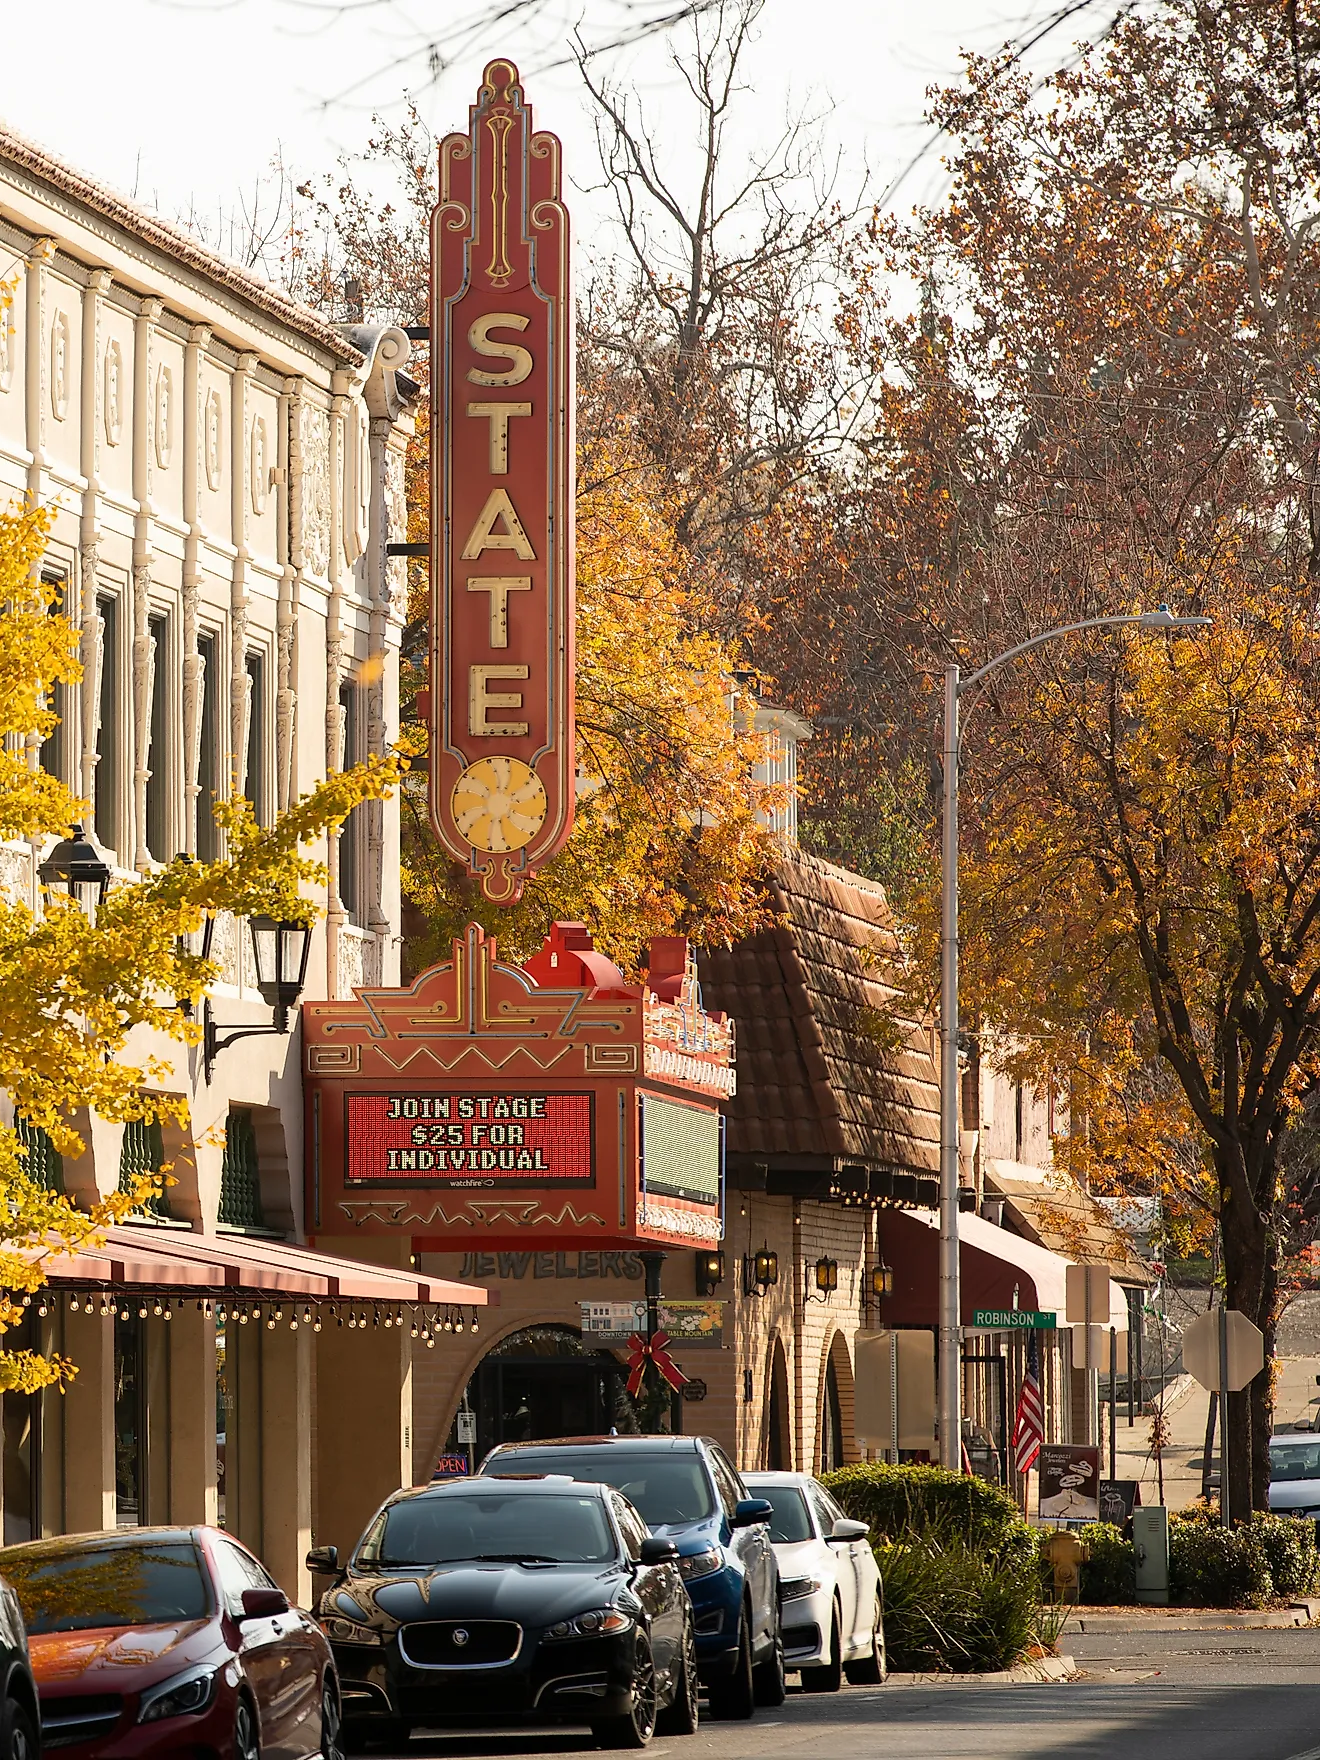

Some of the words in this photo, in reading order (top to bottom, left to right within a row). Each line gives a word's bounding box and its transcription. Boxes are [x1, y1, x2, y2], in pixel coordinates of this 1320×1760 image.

[460, 312, 538, 737] STATE
[388, 1098, 450, 1118] JOIN
[459, 1098, 545, 1118] STAGE
[412, 1125, 463, 1145] $25
[472, 1125, 524, 1145] FOR
[388, 1150, 548, 1170] INDIVIDUAL
[449, 1179, 483, 1187] watchfire
[459, 1251, 644, 1280] JEWELERS
[976, 1312, 1035, 1326] ROBINSON
